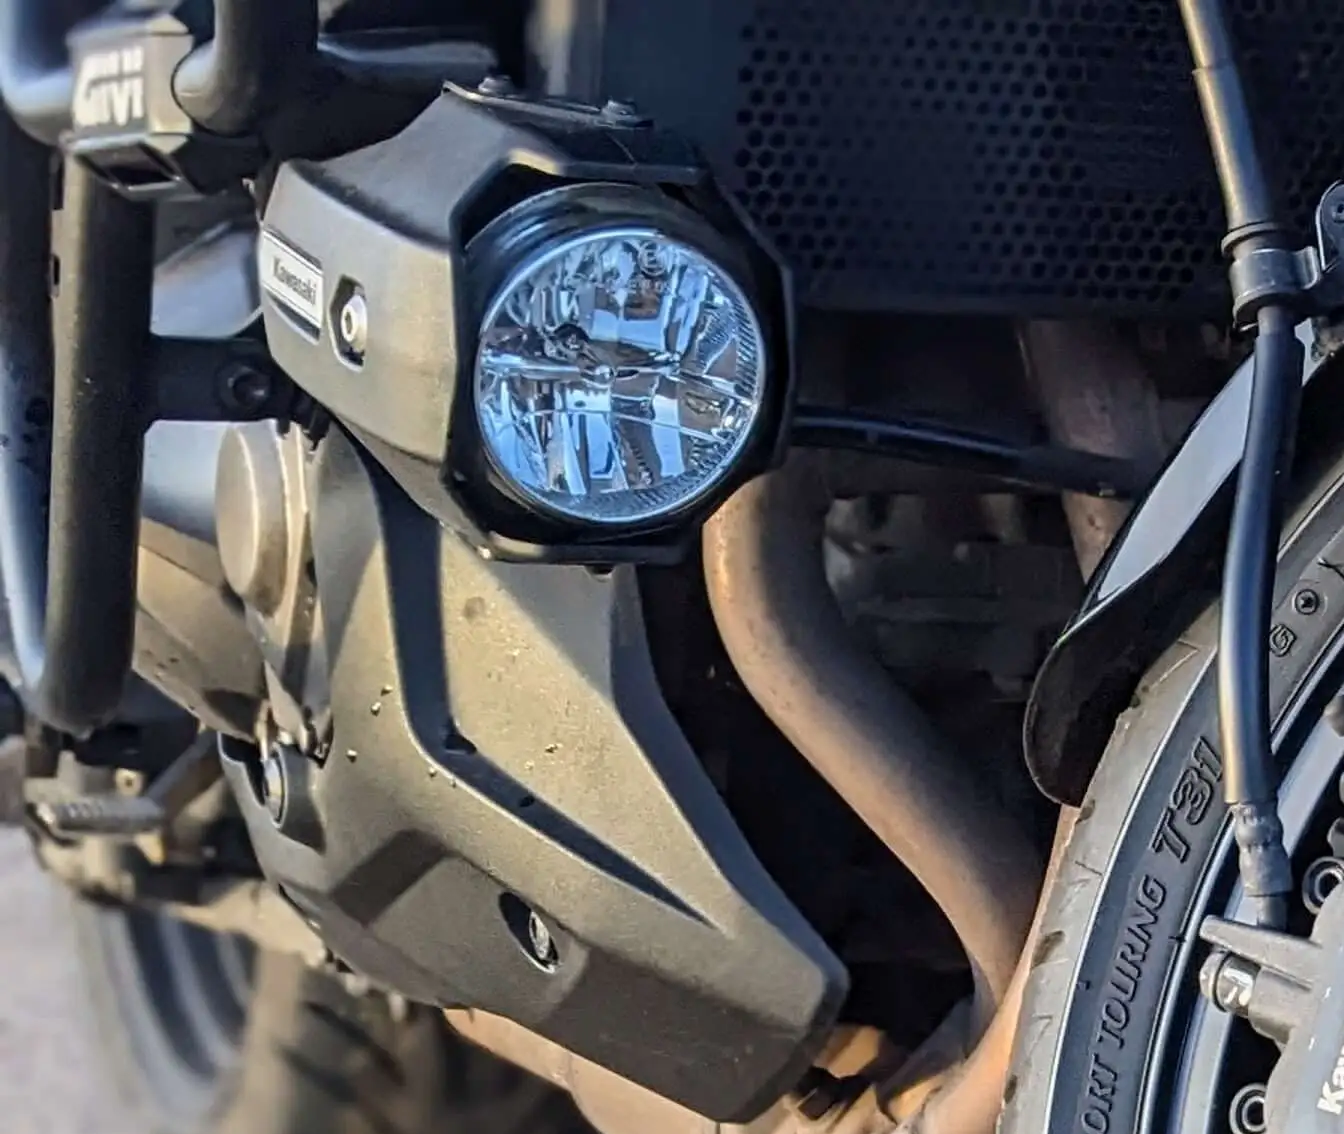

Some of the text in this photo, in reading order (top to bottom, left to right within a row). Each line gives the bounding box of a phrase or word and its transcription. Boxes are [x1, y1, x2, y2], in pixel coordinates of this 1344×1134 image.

[273, 257, 316, 305] Kawasaki
[1098, 873, 1169, 1050] TOURING
[1151, 735, 1224, 864] T31
